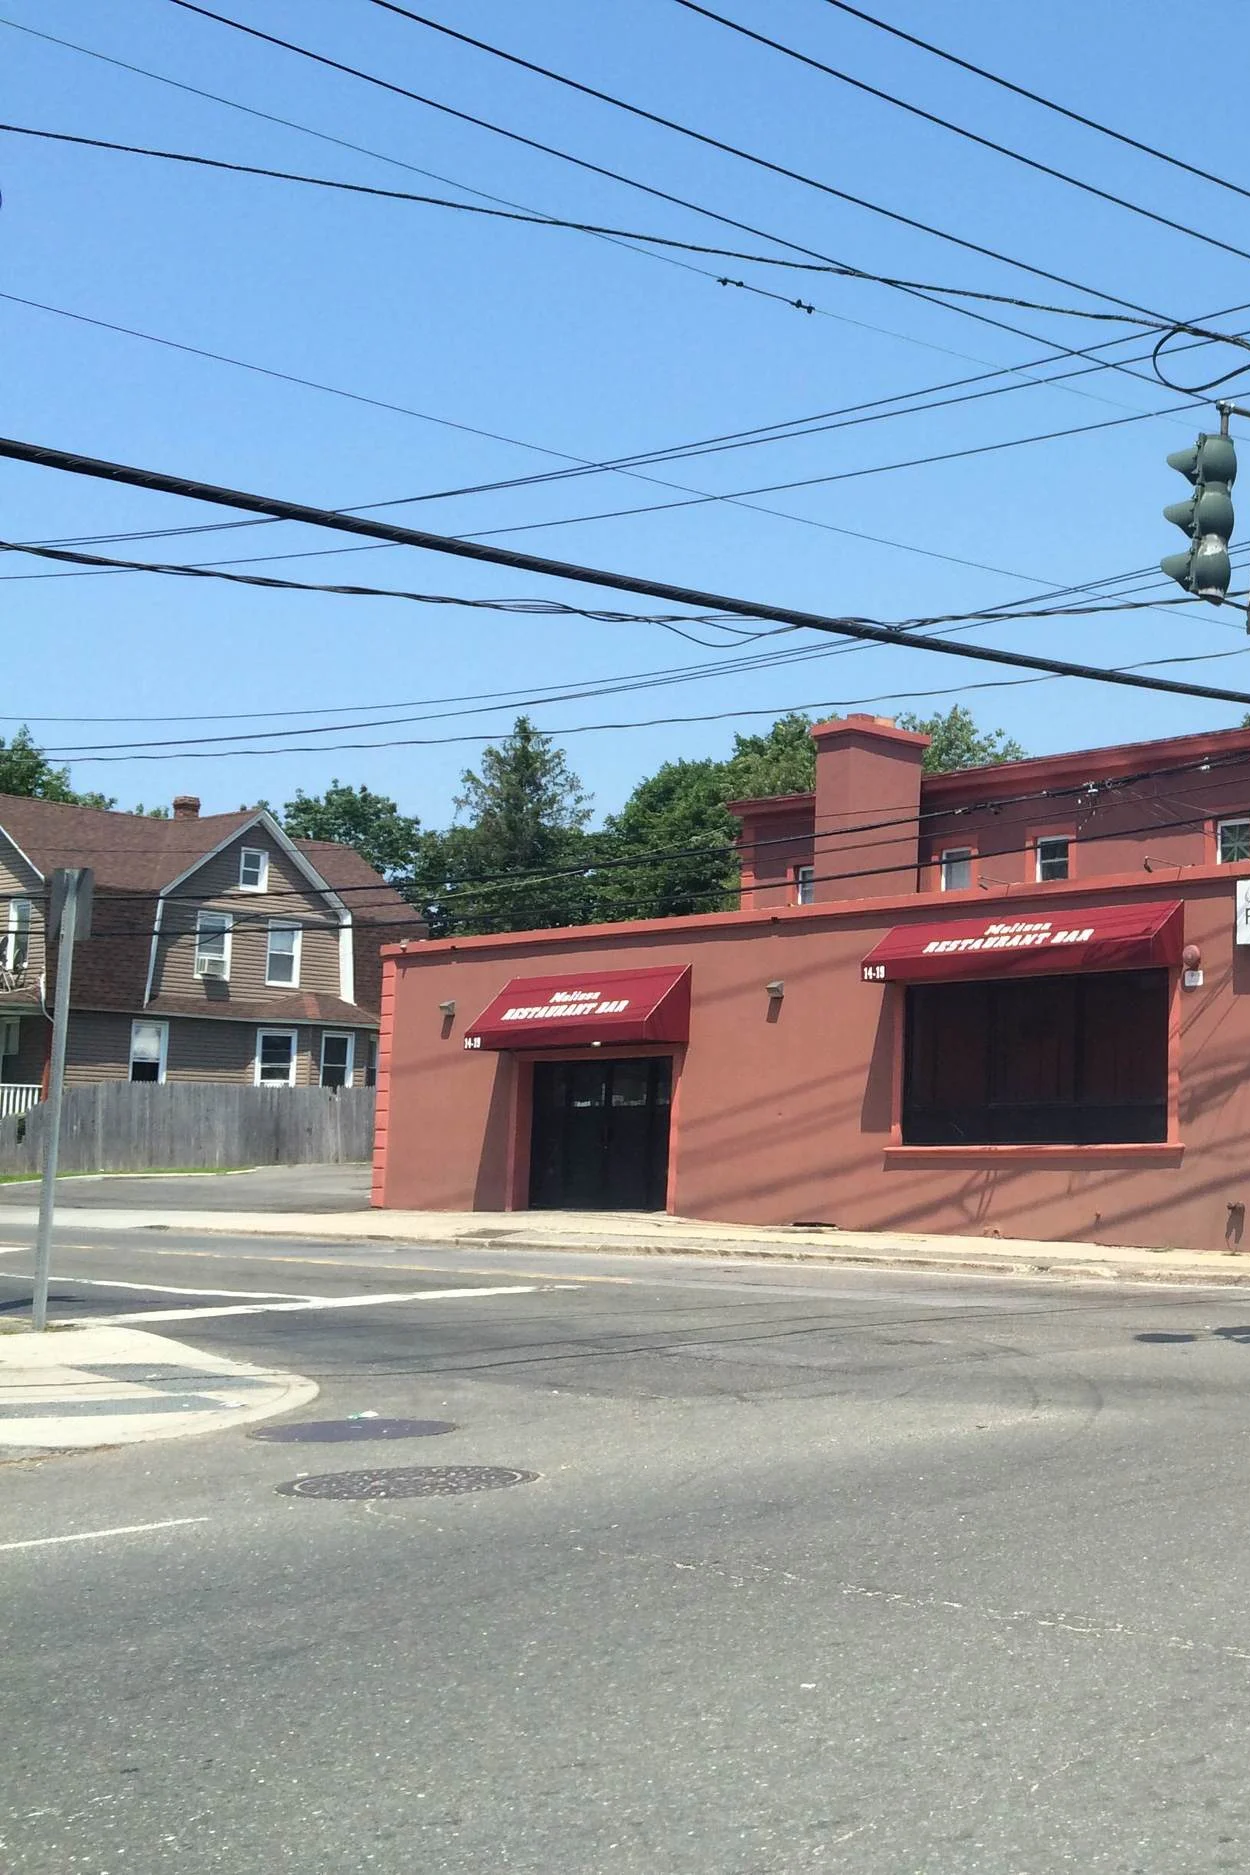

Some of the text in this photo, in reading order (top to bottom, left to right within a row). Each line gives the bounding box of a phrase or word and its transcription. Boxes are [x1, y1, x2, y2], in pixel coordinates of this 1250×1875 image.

[983, 922, 1053, 935] Melissa
[922, 928, 1095, 954] RESTAURANT BAR
[549, 991, 601, 1004] Melissa
[500, 999, 630, 1021] RESTAURANT BAR
